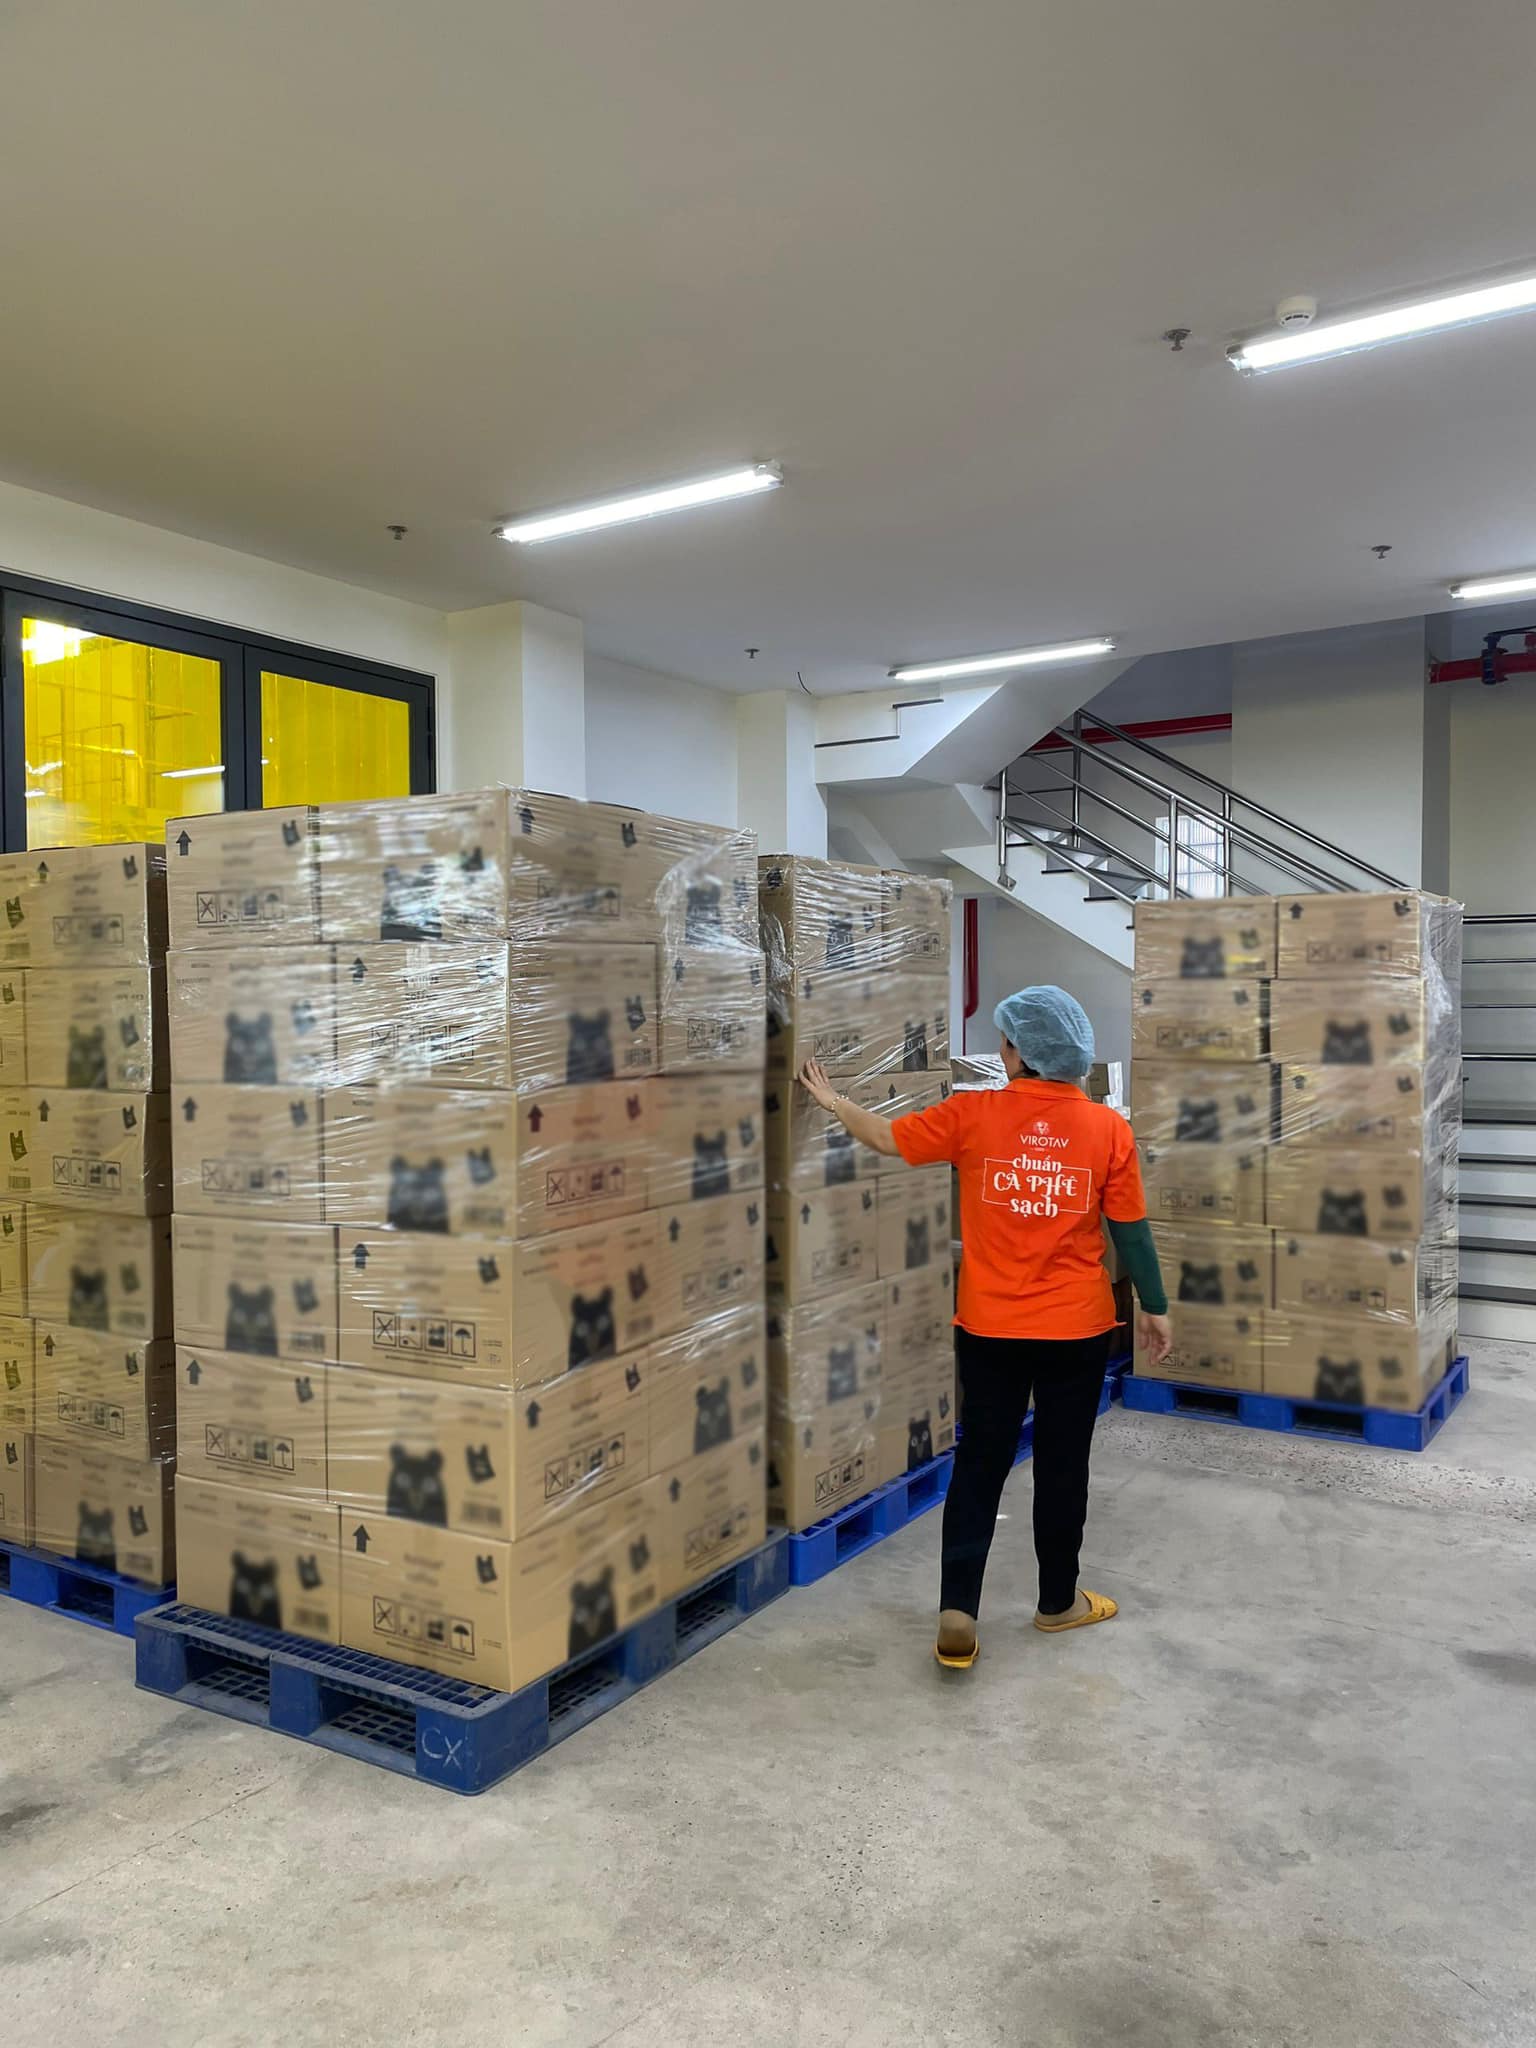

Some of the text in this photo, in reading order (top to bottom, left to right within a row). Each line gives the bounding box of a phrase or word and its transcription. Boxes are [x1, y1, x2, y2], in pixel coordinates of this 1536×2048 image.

[1020, 1134, 1069, 1148] VIROTAV
[993, 1169, 1078, 1198] CÀ PHÊ
[1009, 1196, 1058, 1218] sạch
